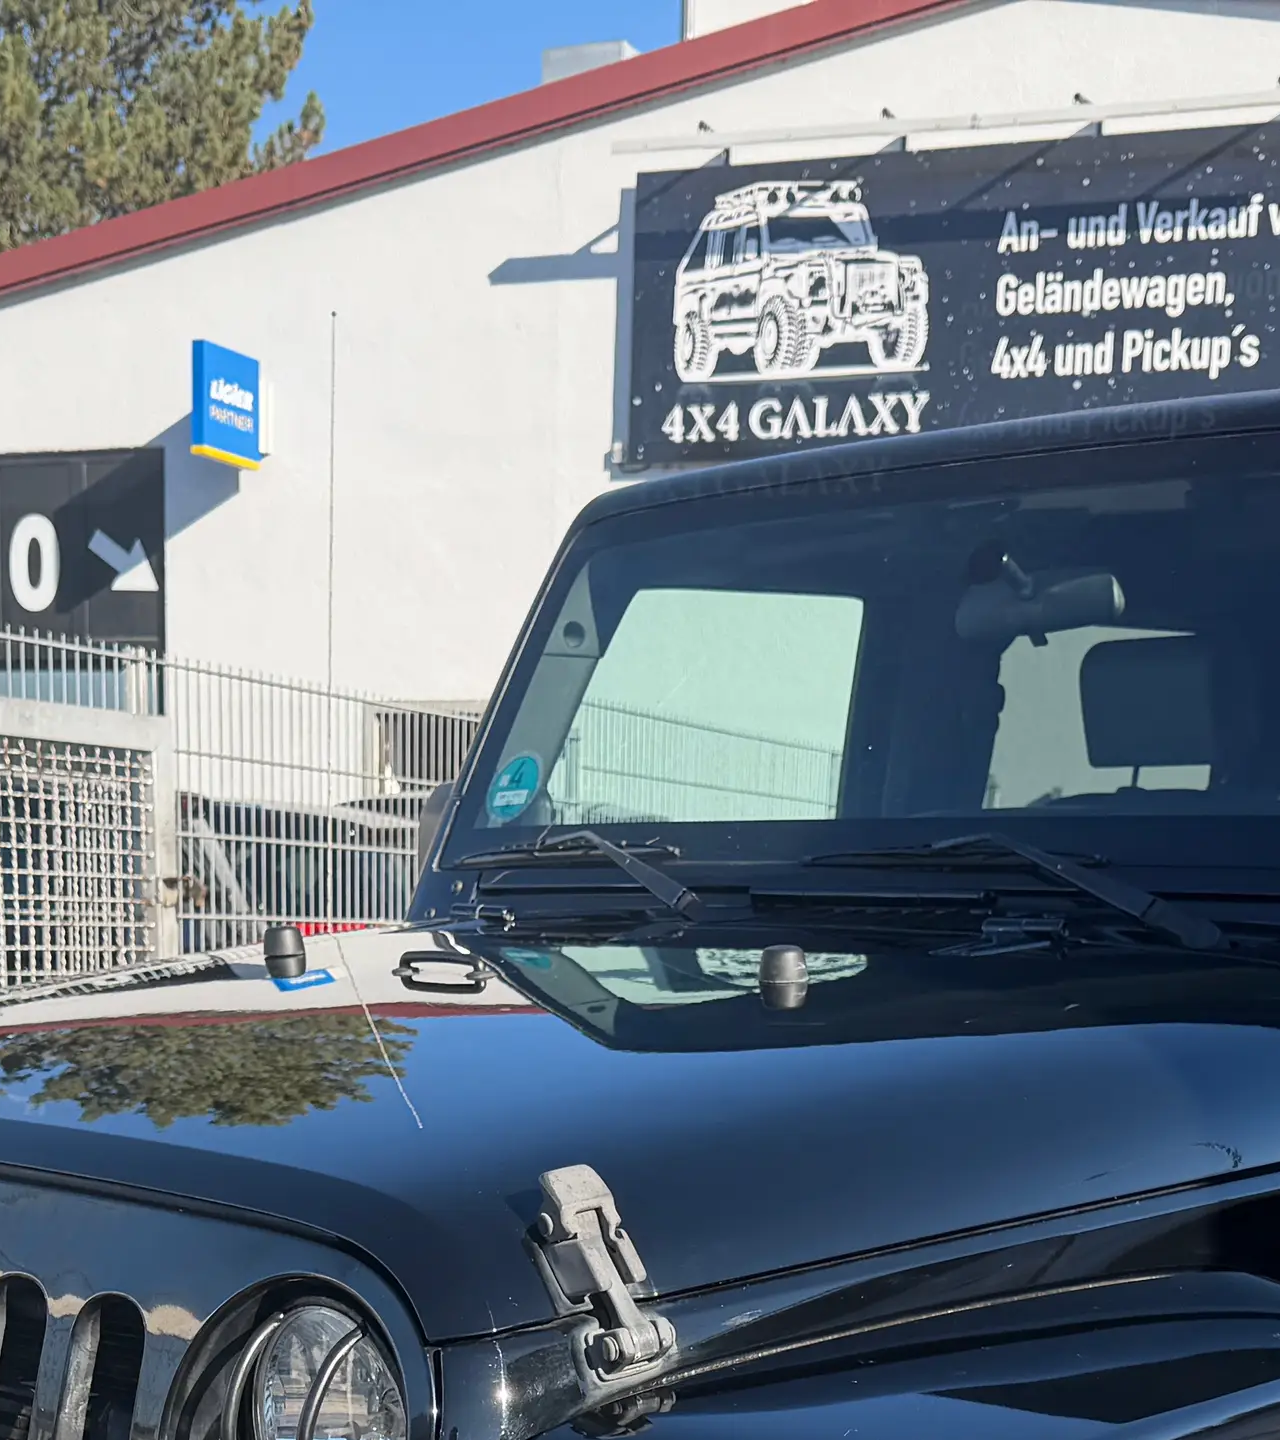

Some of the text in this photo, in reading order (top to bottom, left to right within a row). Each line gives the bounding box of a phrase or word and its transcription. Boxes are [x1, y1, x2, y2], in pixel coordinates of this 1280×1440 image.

[997, 211, 1058, 254] An-
[1067, 202, 1127, 250] und
[1137, 193, 1264, 244] Verkauf
[995, 268, 1235, 318] Geländewagen,
[991, 332, 1048, 379] 4x4
[1054, 330, 1115, 377] und
[748, 390, 931, 440] GALAXY
